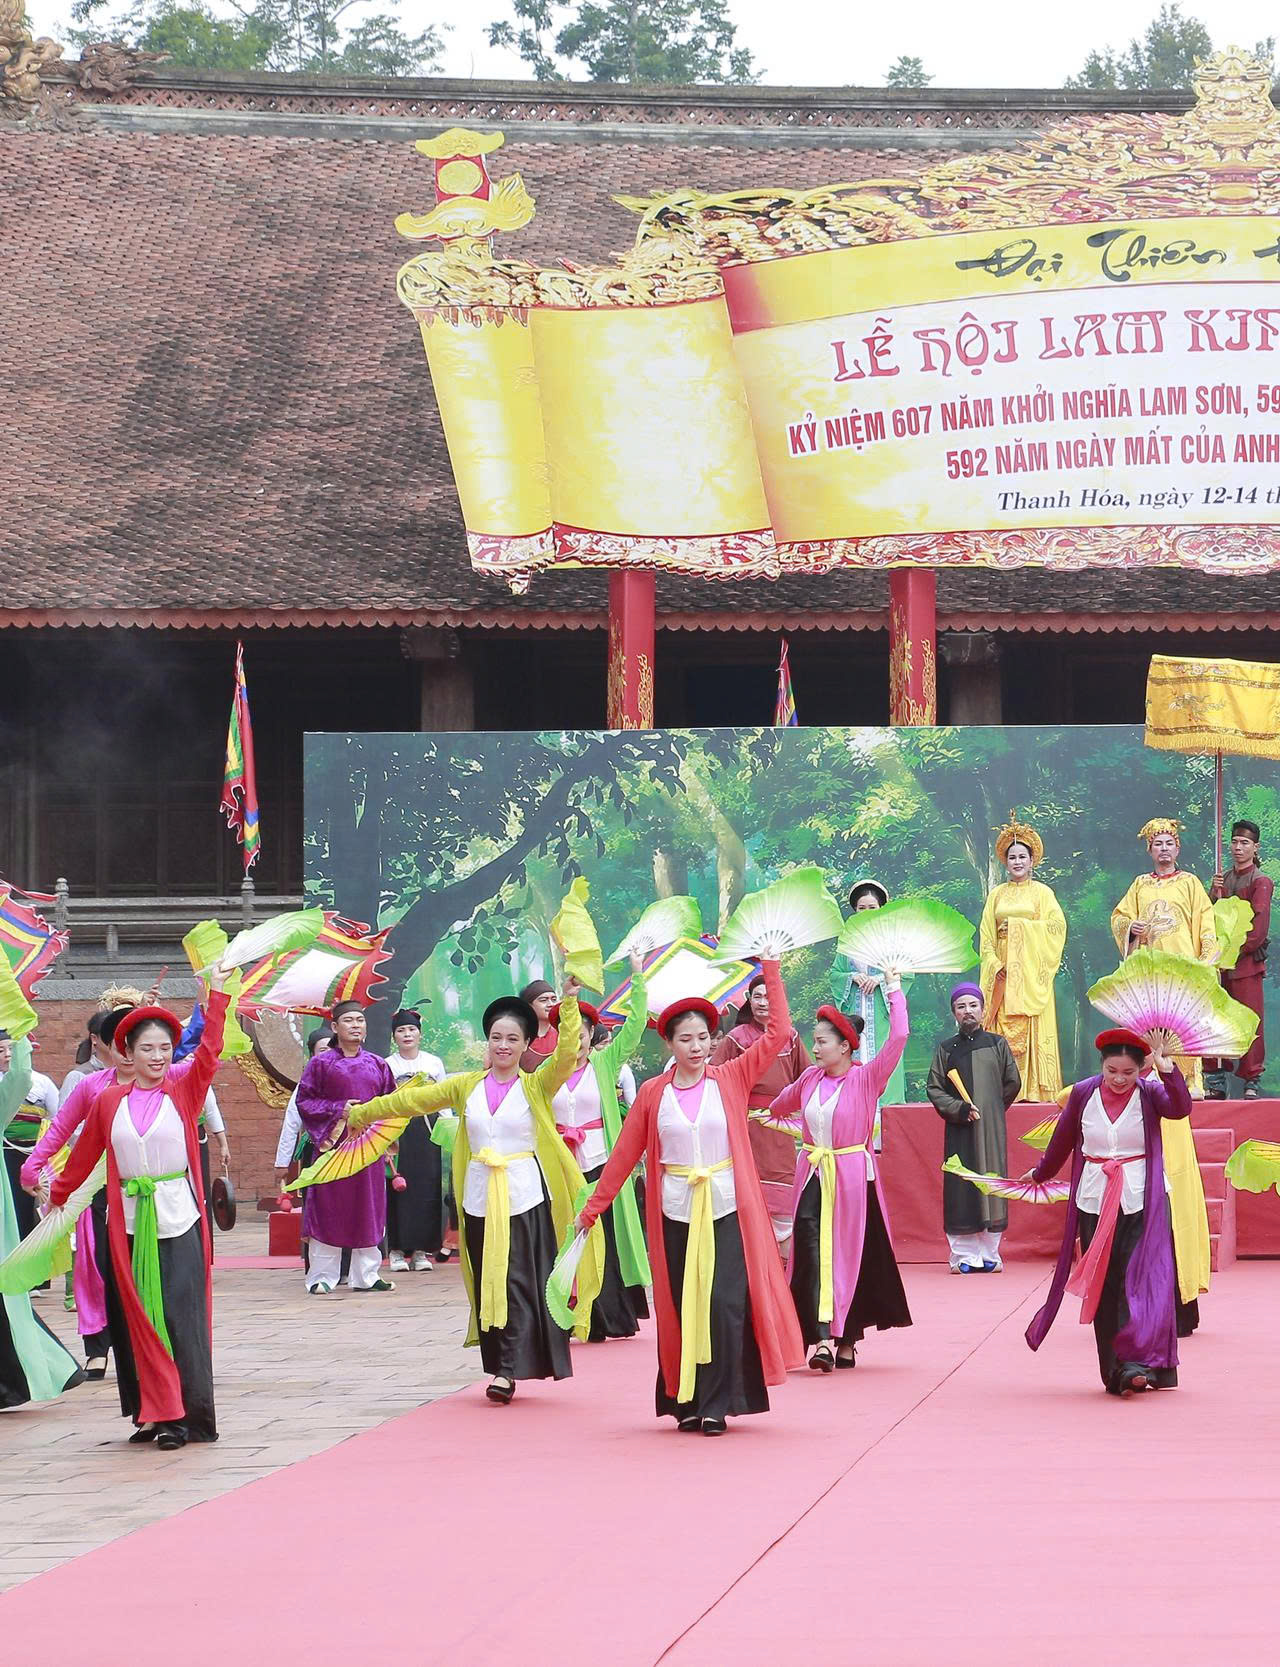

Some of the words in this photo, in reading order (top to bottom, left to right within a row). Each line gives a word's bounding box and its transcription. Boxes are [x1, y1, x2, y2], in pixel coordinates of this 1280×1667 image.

[955, 239, 1063, 281] Đại
[1087, 228, 1226, 282] Thiên
[831, 317, 900, 382] LỄ
[1039, 311, 1166, 358] LAM
[789, 412, 816, 454] KỶ
[826, 409, 886, 449] NIỆM
[892, 405, 932, 439] 607
[942, 395, 993, 432] NĂM
[1002, 384, 1055, 426] KHỞI
[1063, 383, 1132, 421] NGHĨA
[1139, 386, 1187, 417] LAM
[1193, 383, 1249, 420] SƠN,
[945, 448, 988, 480] 592
[995, 439, 1049, 476] NĂM
[1056, 434, 1118, 470] NGÀY
[1124, 423, 1172, 466] MẤT
[1180, 422, 1226, 464] CỦA
[1233, 433, 1280, 463] ANH
[997, 490, 1071, 512] Thanh
[1078, 488, 1131, 511] Hóa,
[1138, 488, 1195, 511] ngày
[1201, 486, 1258, 506] 12-14
